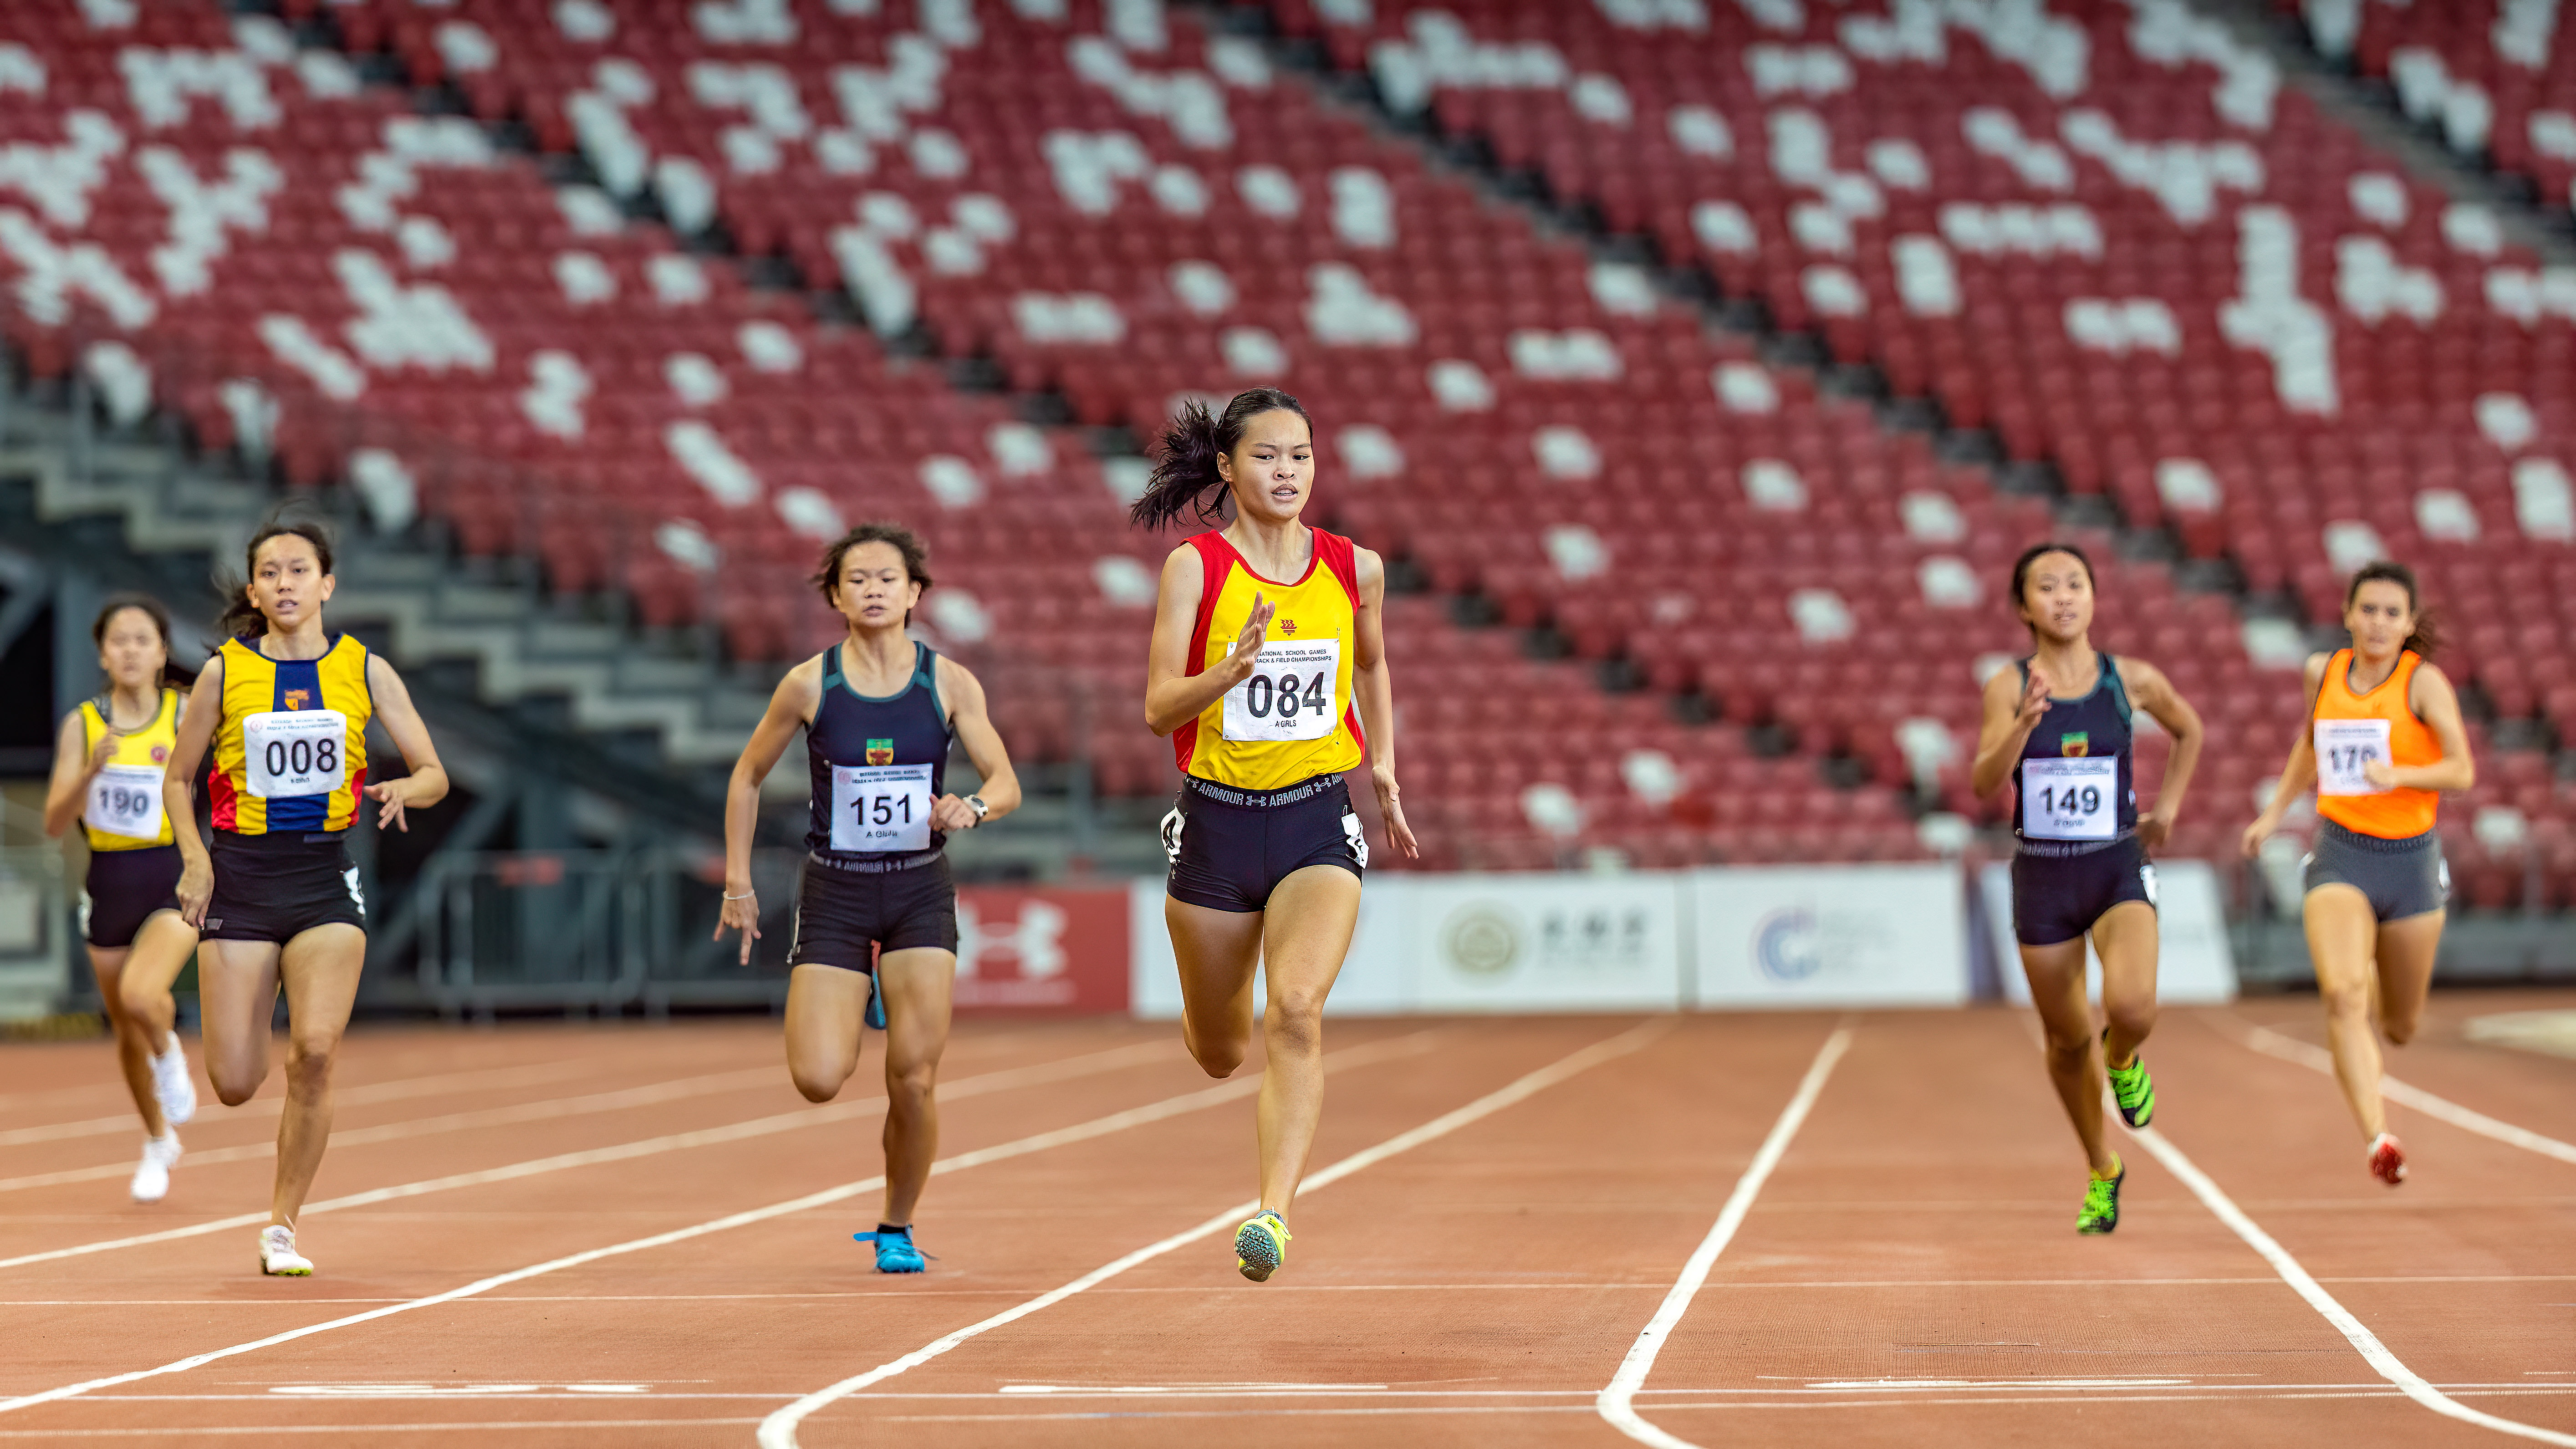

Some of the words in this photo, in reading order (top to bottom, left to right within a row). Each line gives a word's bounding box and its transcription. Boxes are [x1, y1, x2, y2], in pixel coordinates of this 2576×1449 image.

[1248, 672, 1326, 718] 084
[266, 739, 337, 776] 008
[99, 786, 149, 818] 190
[850, 794, 909, 825] 151
[1198, 782, 1244, 806] ARMOUR
[1269, 785, 1314, 807] ARMOUR
[2039, 785, 2101, 816] 149
